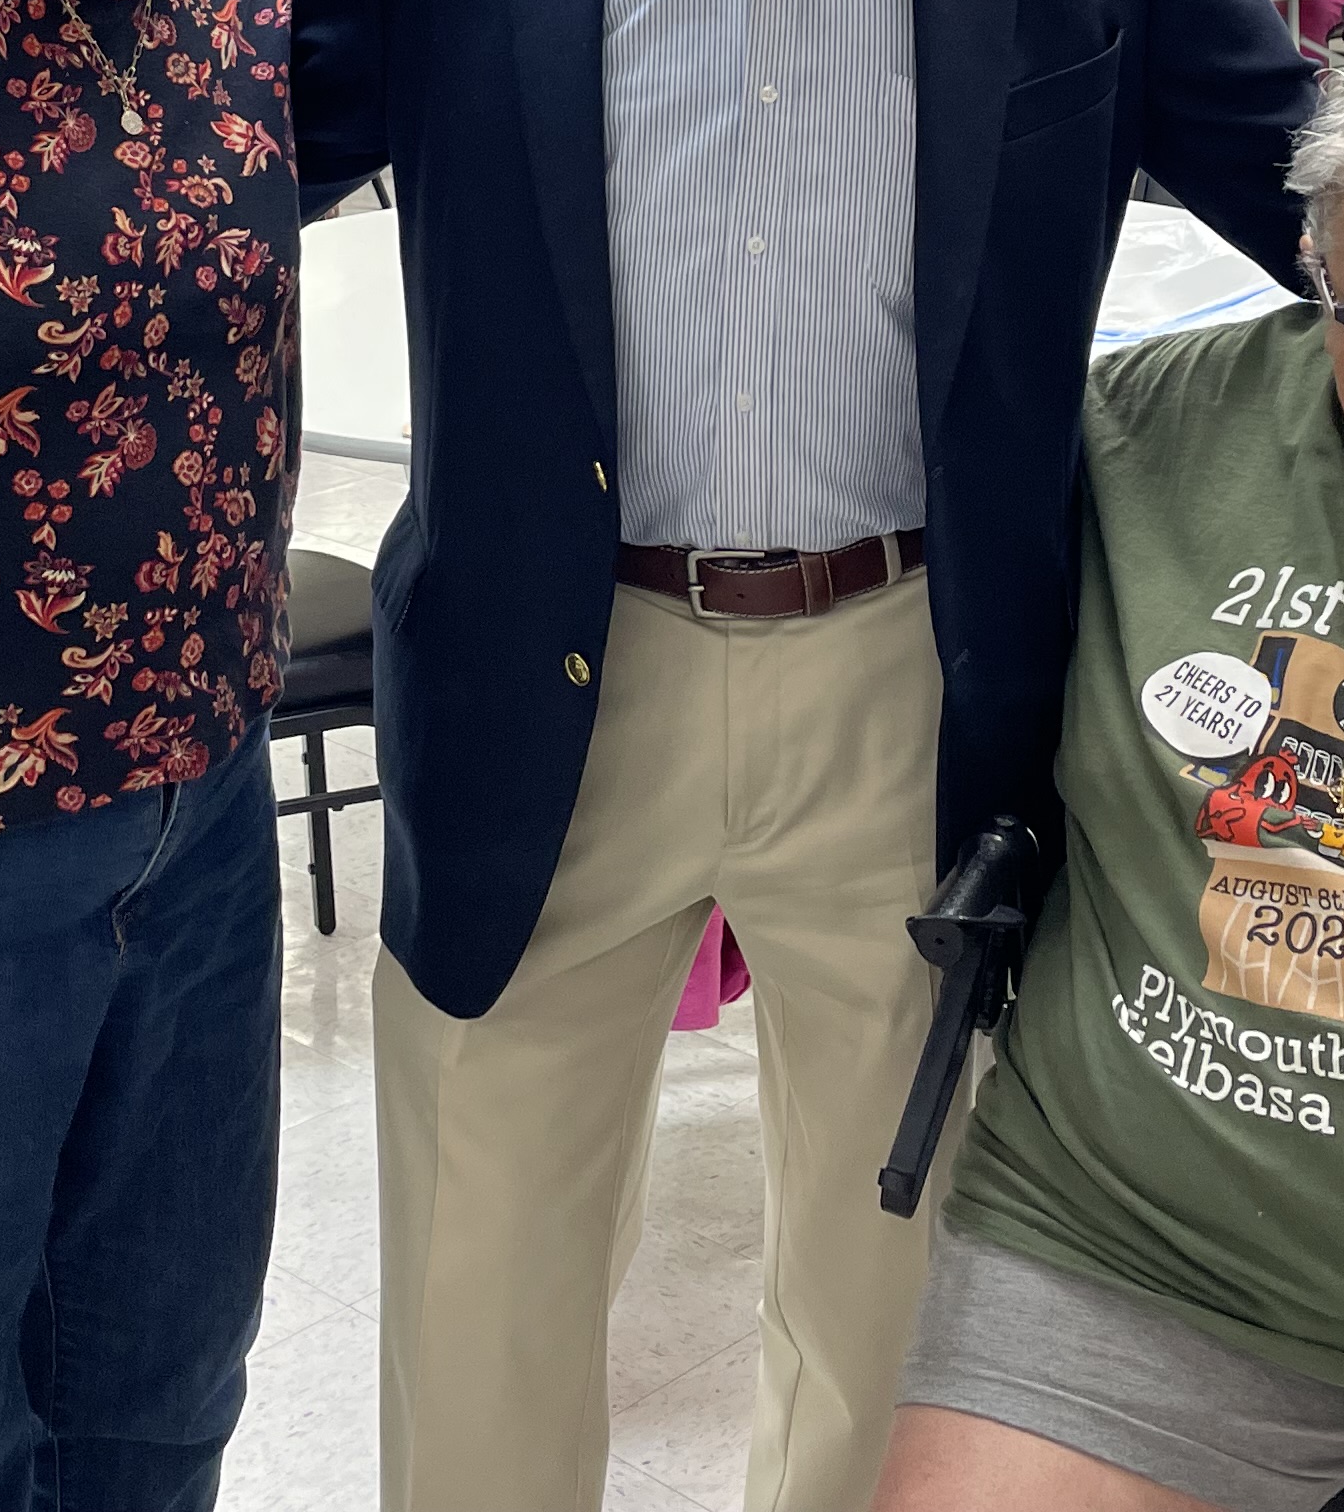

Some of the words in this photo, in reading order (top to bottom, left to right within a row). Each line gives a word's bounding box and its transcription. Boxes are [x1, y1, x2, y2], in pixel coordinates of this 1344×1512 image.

[1154, 684, 1182, 709] 21
[1181, 694, 1243, 744] YEARS!
[1173, 660, 1232, 705] CHEERS
[1234, 693, 1263, 719] TO
[1210, 875, 1312, 908] AUGUST
